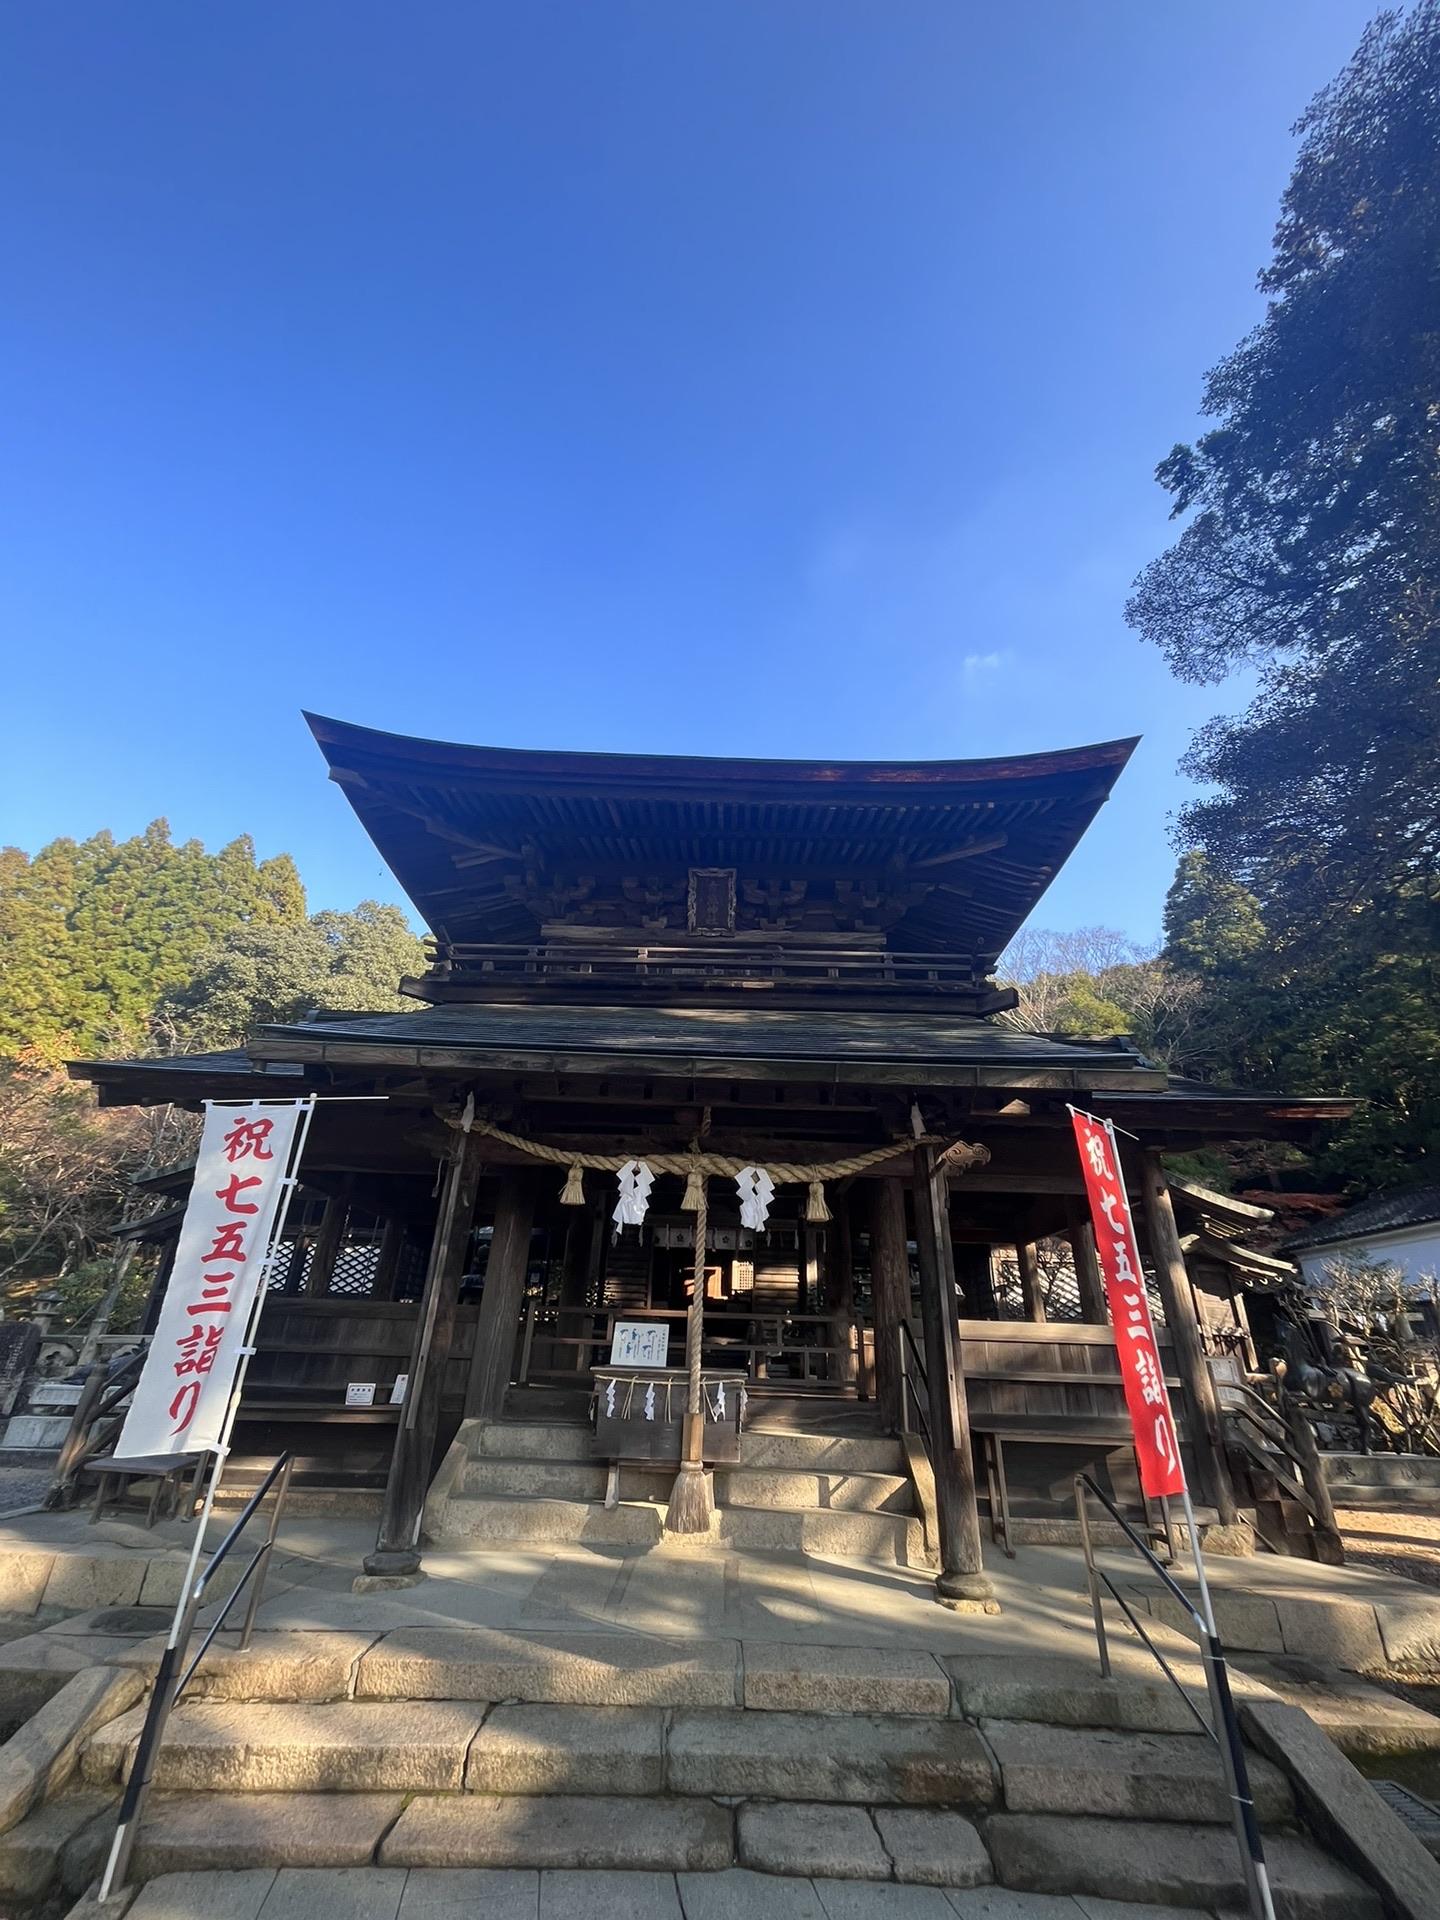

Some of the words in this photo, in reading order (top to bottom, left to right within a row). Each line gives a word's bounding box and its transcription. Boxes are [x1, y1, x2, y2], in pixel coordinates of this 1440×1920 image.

[169, 1117, 274, 1436] 祝七五三詣り
[1084, 1128, 1176, 1475] 祝七五三詣り
